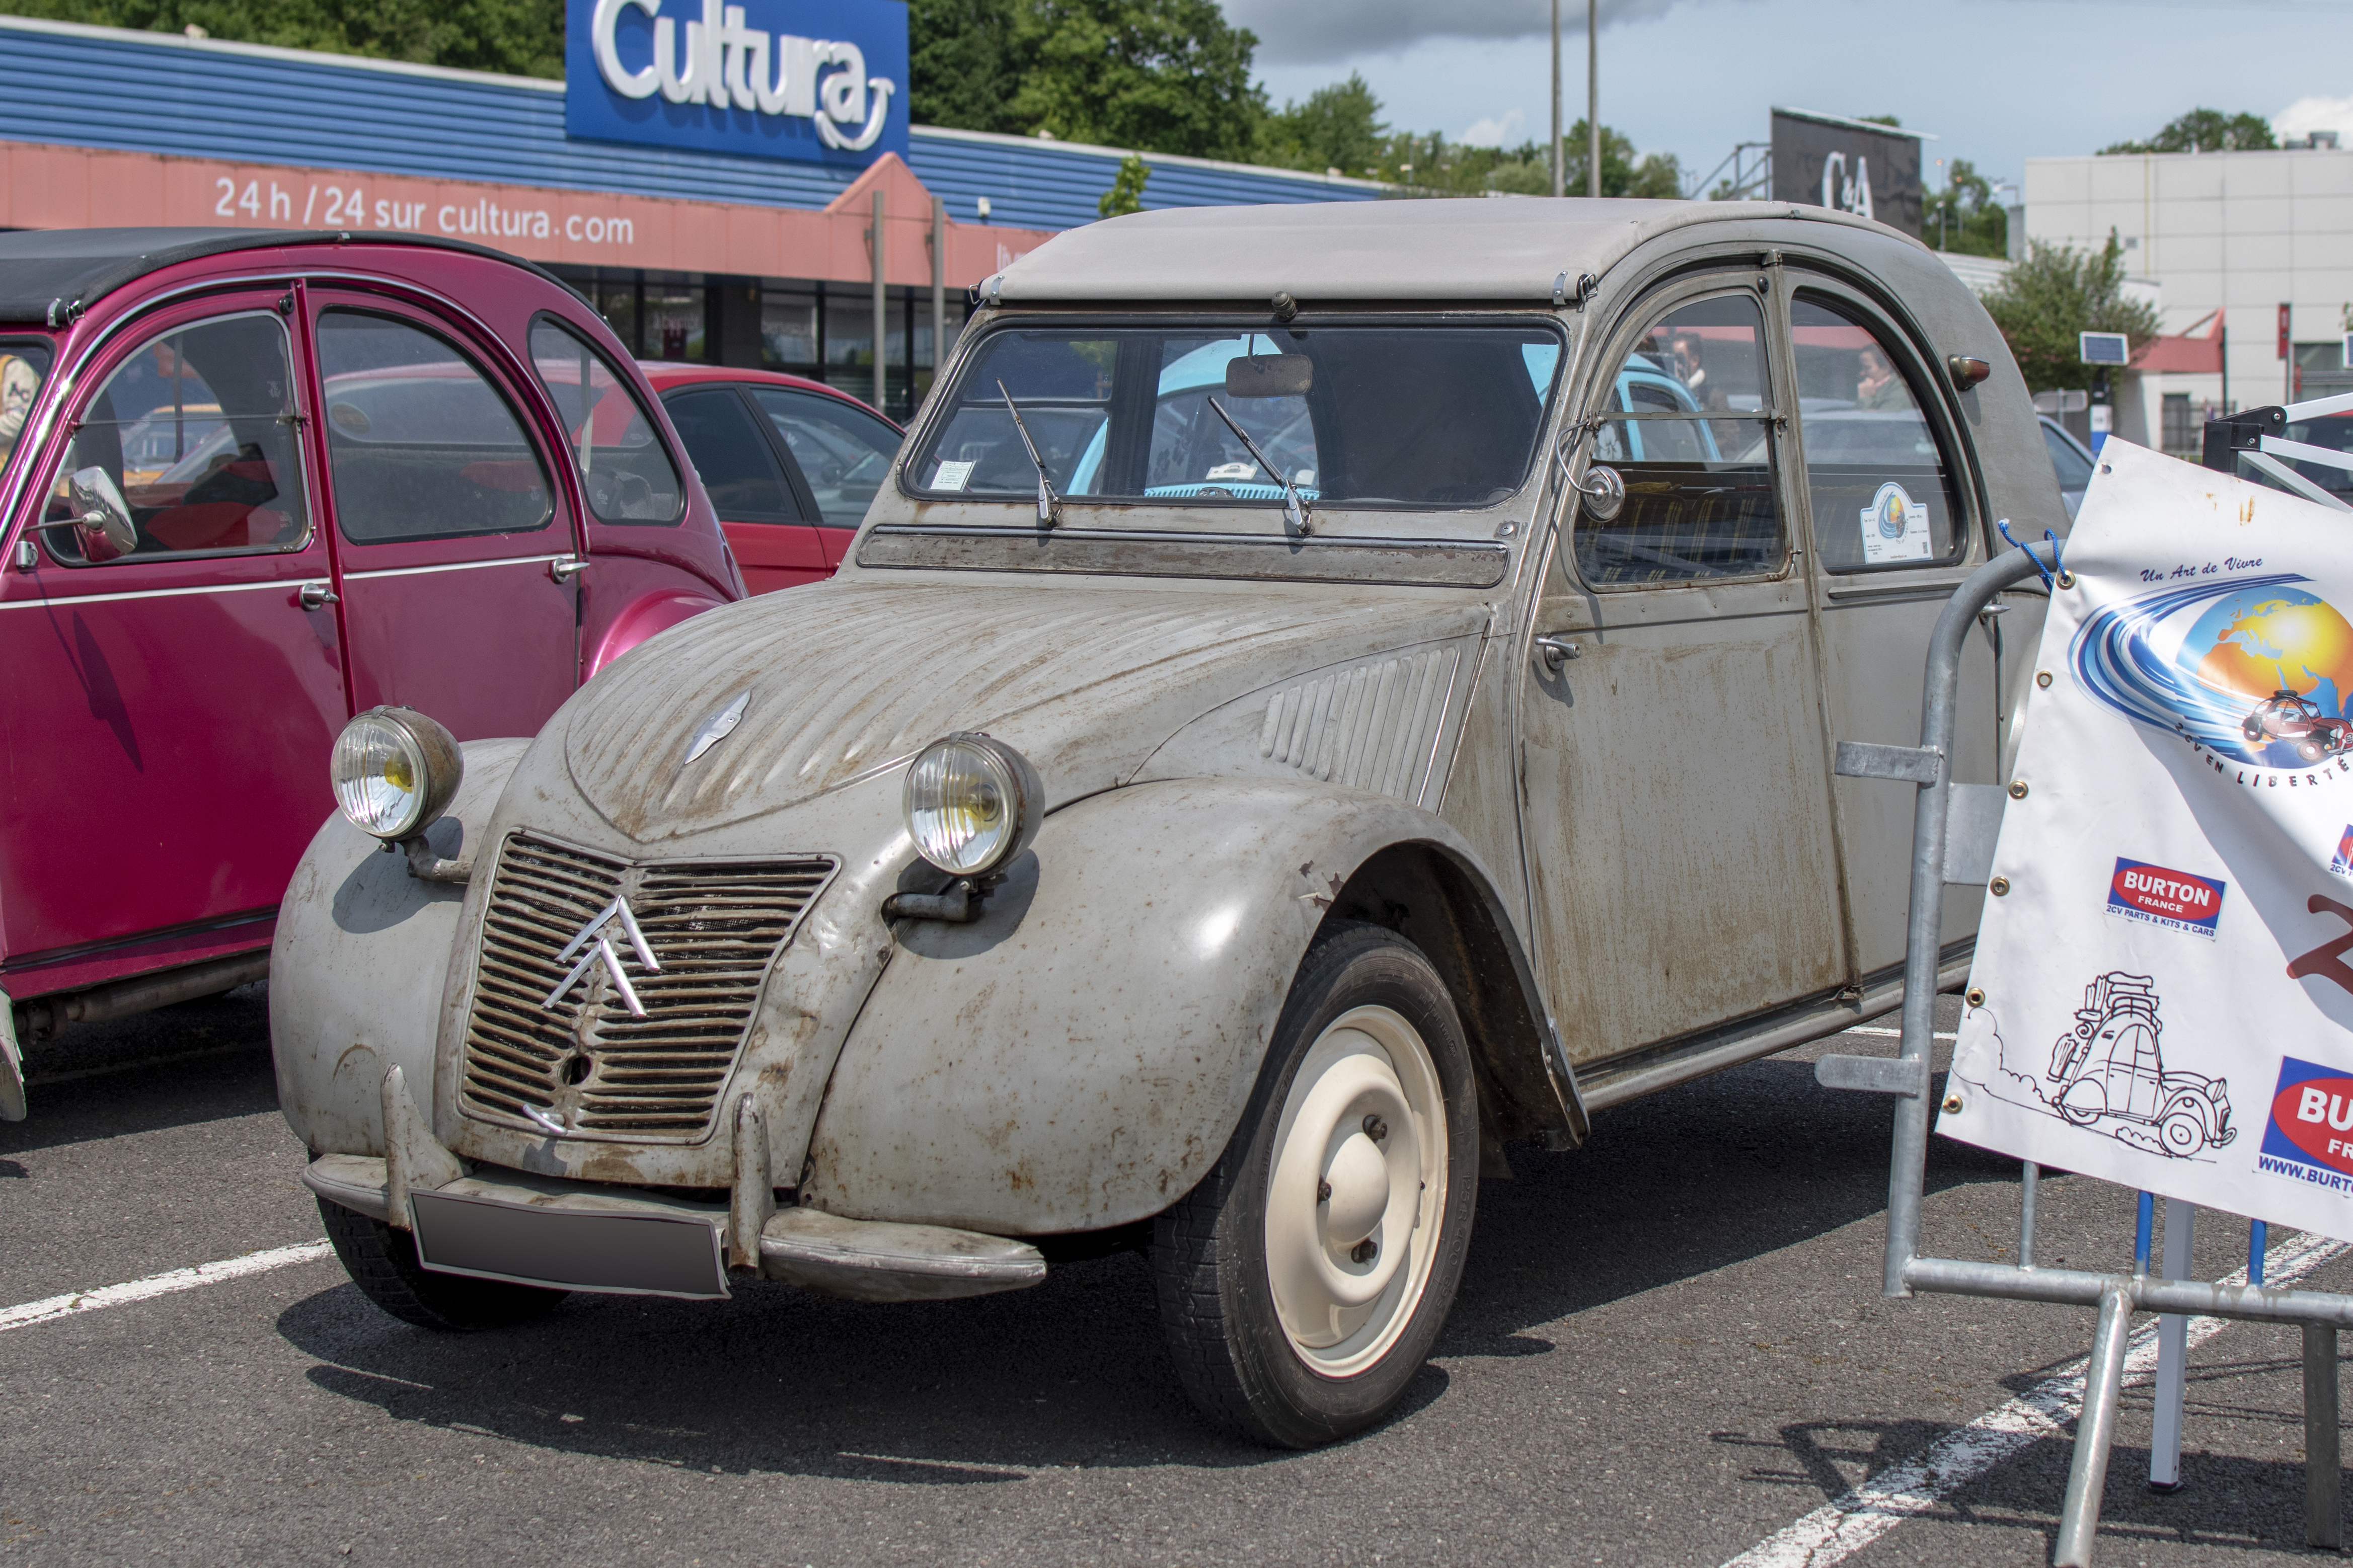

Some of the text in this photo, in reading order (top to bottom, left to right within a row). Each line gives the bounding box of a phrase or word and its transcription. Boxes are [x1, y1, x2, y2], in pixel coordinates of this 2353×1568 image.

[592, 0, 867, 124] Cultura
[1822, 151, 1874, 219] C&A
[374, 199, 427, 229] sur
[437, 198, 634, 245] cultura.com
[2140, 557, 2263, 582] Un Art de Vivre
[2206, 754, 2224, 774] EN
[2236, 756, 2349, 787] LIBERTÉ
[2329, 864, 2346, 875] 2CV
[2123, 871, 2210, 907] BURTON
[2138, 895, 2184, 913] FRANCE
[2106, 905, 2123, 914] 2CV
[2124, 909, 2150, 921] PARTS
[2160, 918, 2180, 928] KITS
[2191, 925, 2215, 937] CARS
[1258, 1039, 1306, 1191] MICHELIN
[2258, 1154, 2353, 1195] WWW.BURT
